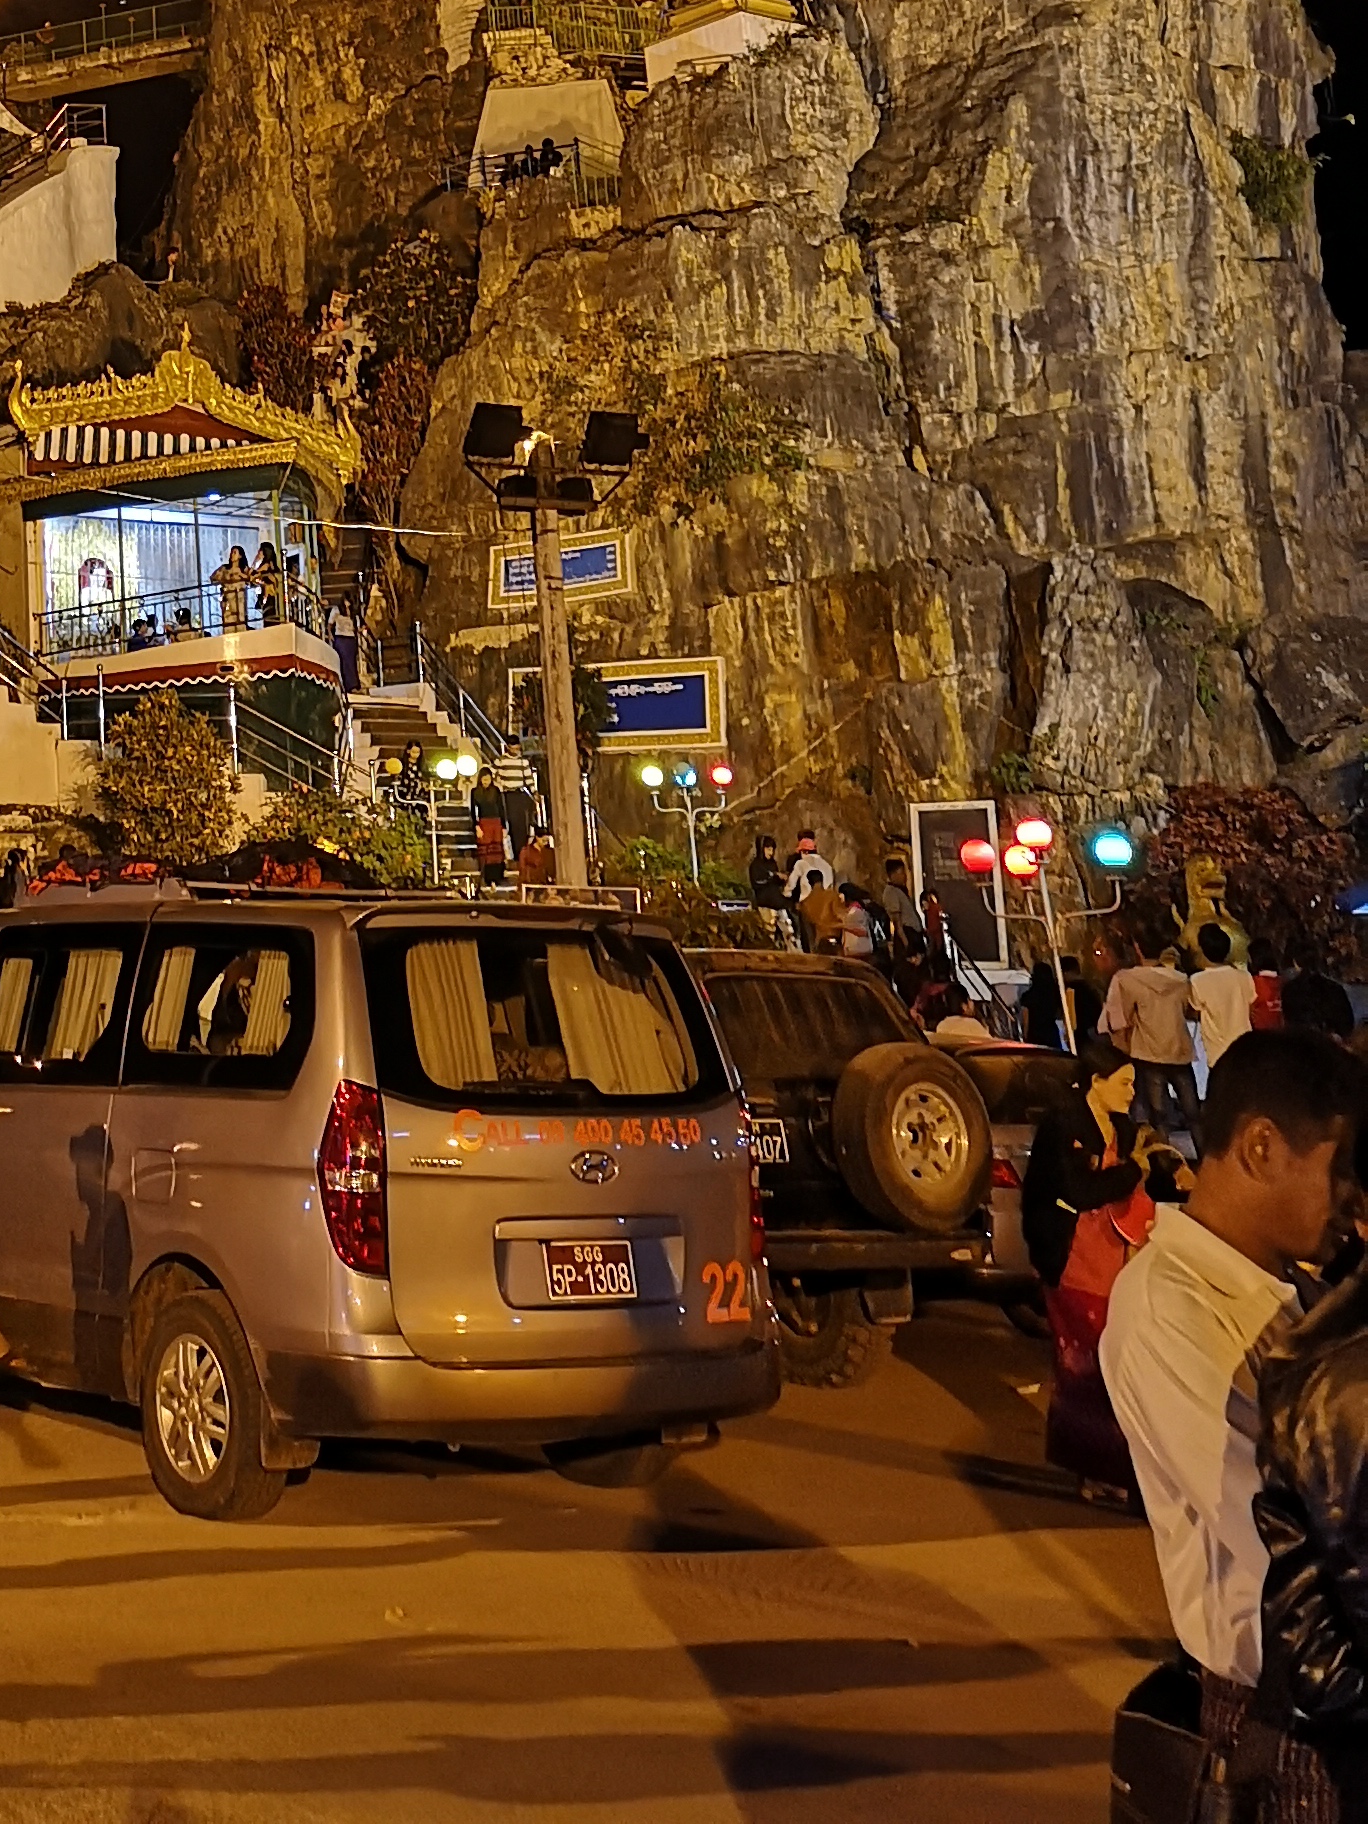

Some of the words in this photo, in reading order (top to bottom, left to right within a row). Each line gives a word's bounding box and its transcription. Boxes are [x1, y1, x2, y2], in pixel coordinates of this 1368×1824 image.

[574, 1118, 614, 1146] 400
[619, 1118, 646, 1146] 45
[574, 1246, 603, 1263] SGG
[552, 1262, 631, 1295] 5P-1308
[702, 1260, 752, 1324] 22
